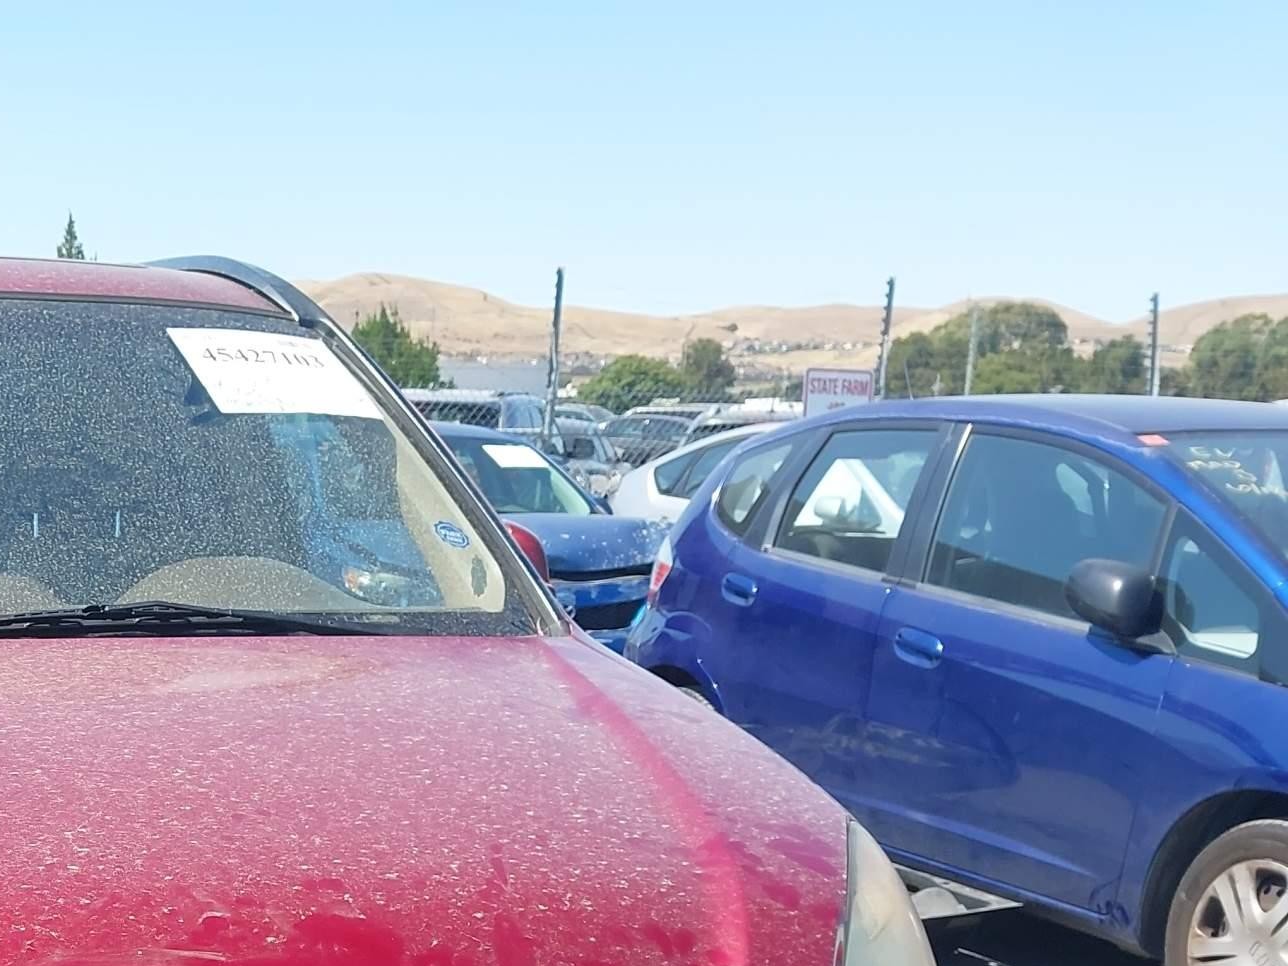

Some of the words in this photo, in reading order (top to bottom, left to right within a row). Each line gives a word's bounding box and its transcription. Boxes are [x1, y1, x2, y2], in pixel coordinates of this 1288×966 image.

[202, 348, 326, 369] 45427103
[810, 378, 839, 395] STATE
[841, 379, 869, 396] FARM
